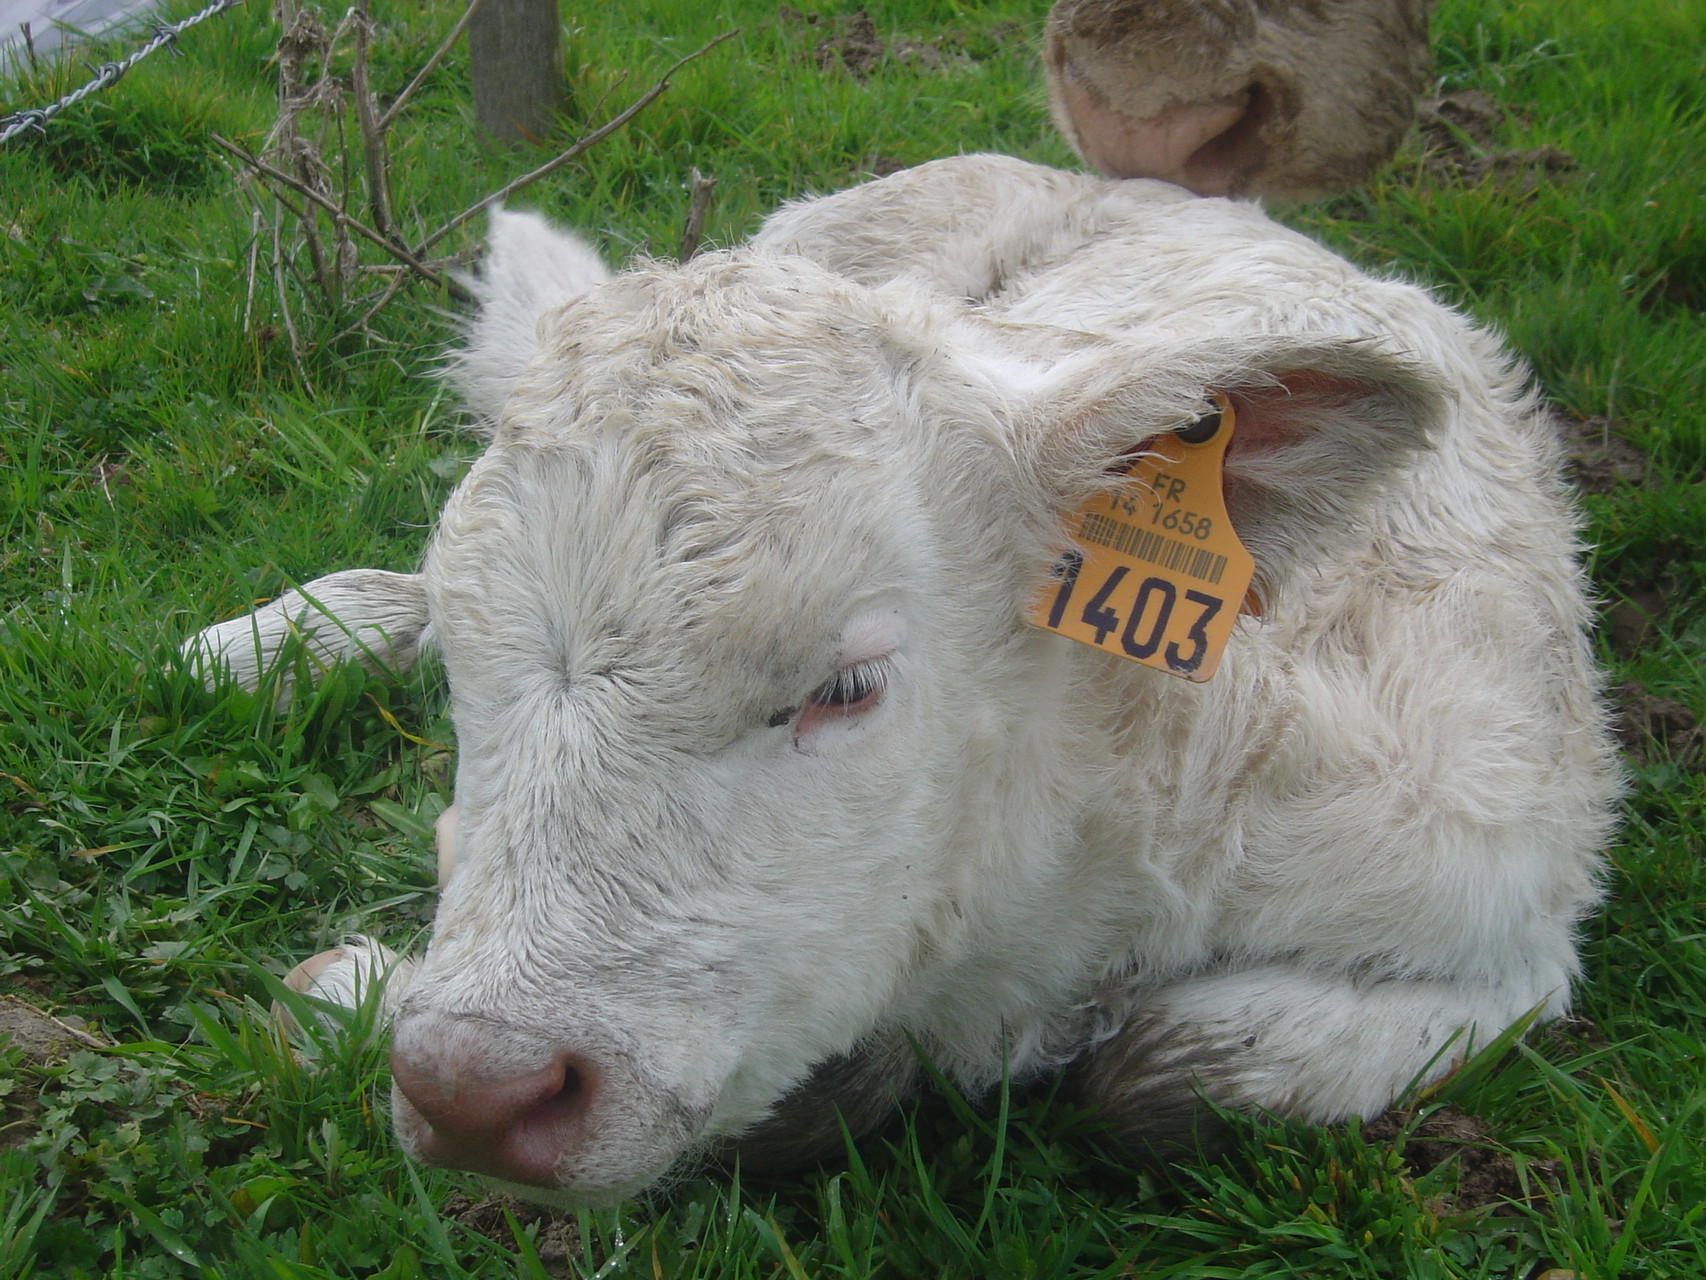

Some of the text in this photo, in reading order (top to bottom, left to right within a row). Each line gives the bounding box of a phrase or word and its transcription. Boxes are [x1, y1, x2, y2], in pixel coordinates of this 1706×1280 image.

[1151, 472, 1186, 503] FR
[1152, 502, 1212, 540] 1658
[1047, 550, 1223, 673] 1403
